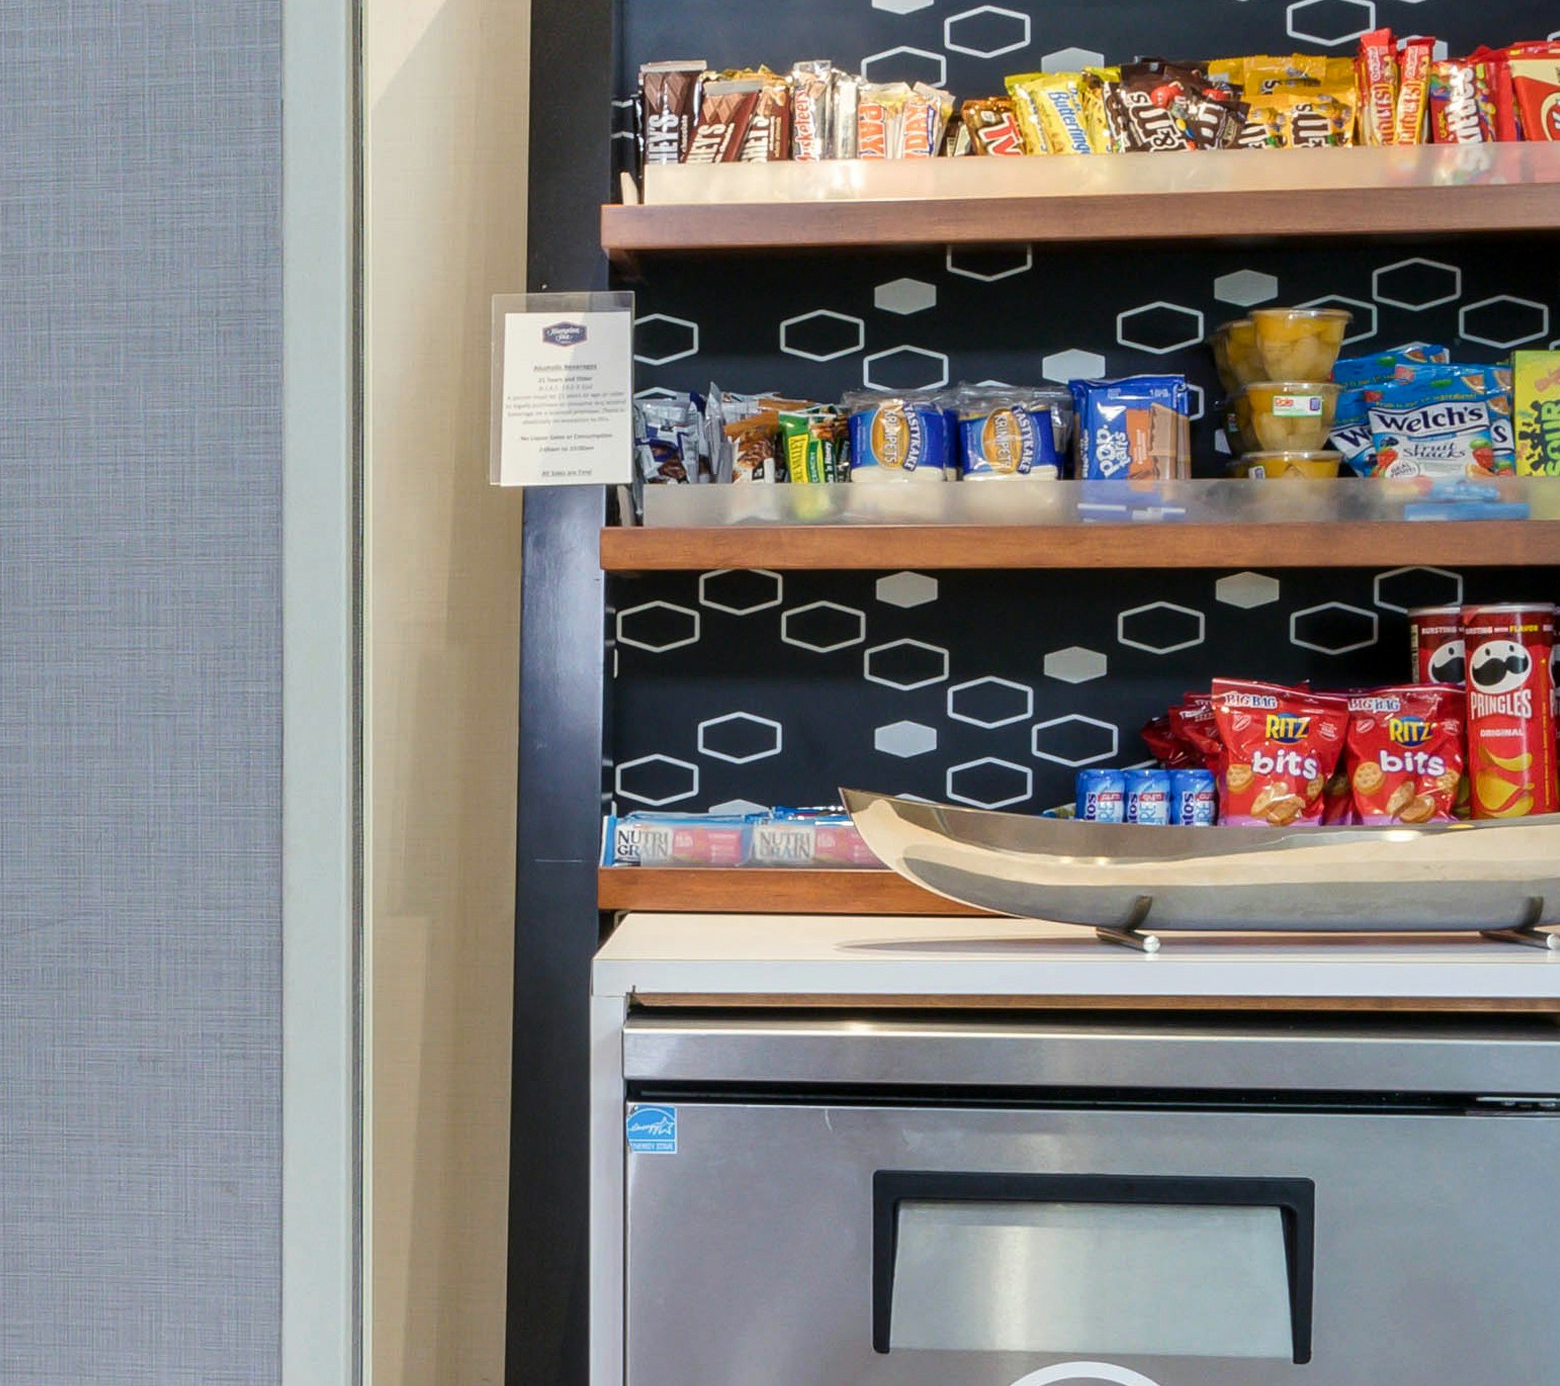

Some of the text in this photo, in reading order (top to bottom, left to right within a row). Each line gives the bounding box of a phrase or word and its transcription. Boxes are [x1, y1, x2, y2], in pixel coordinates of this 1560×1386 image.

[1376, 406, 1484, 433] Welch's
[883, 409, 898, 465] KRIMPETS
[903, 403, 921, 471] TASTYKAKE
[1012, 404, 1032, 474] TASTYKAKE
[1403, 448, 1466, 460] Snacks
[1509, 624, 1539, 633] FLAVOR
[1225, 693, 1277, 710] BIG BAG
[1348, 698, 1372, 711] BIG
[1470, 688, 1532, 720] PRINGLES
[1265, 714, 1309, 740] RITZ
[1388, 716, 1434, 743] RITZ
[1480, 728, 1525, 737] ORIGINAL
[1251, 749, 1319, 781] bits
[1379, 749, 1446, 777] bits
[617, 829, 669, 845] NUTRI
[760, 830, 811, 845] NUTRI
[617, 844, 670, 858] GRAIN
